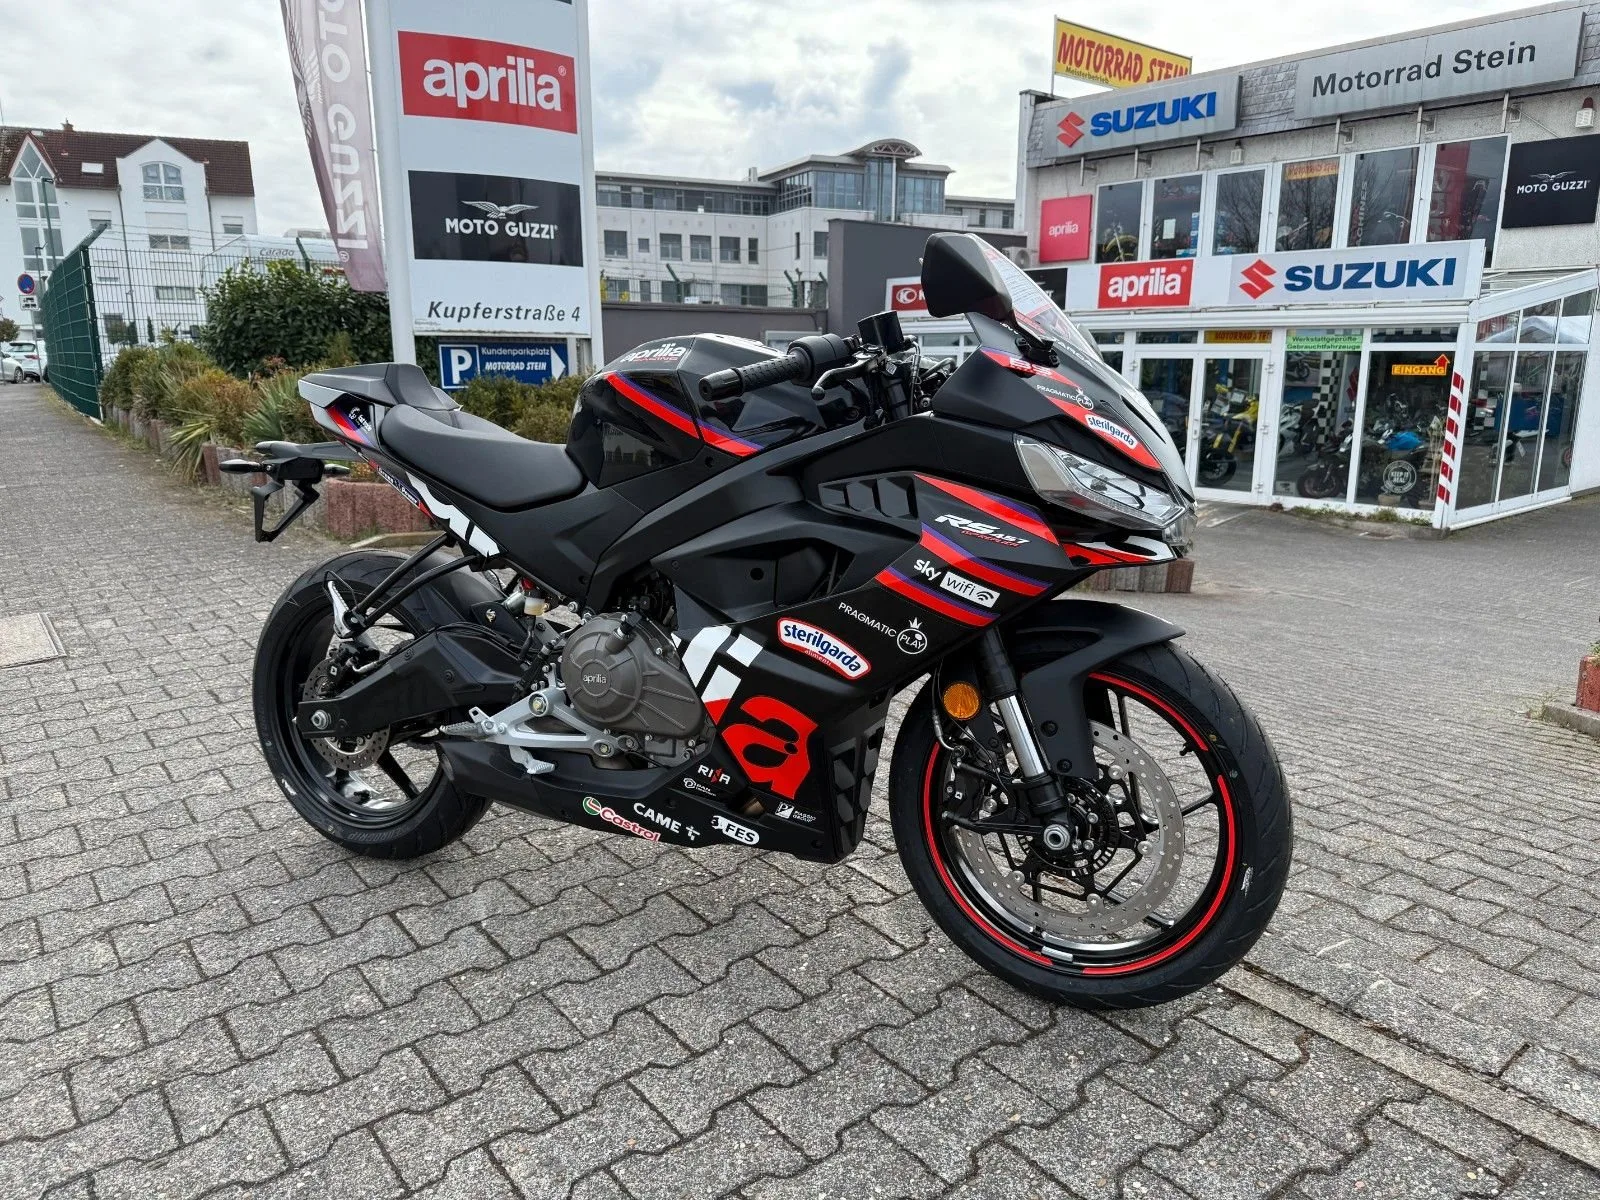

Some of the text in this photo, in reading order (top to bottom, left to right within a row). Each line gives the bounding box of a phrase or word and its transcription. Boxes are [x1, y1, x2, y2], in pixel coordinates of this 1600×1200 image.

[1057, 32, 1143, 83] MOTORRAD
[1312, 41, 1536, 97] Motorrad Stein
[423, 55, 562, 112] aprilia
[1090, 91, 1217, 137] SUZUKI
[1517, 180, 1587, 195] MOTO GUZZI
[445, 218, 556, 239] MOTO GUZZI
[1049, 220, 1079, 237] aprilia
[1108, 267, 1181, 302] aprilia
[1284, 257, 1457, 292] SUZUKI
[428, 301, 581, 323] Kupferstraße 4
[450, 348, 473, 385] P
[481, 347, 550, 357] Kundenparkplatz
[485, 361, 547, 371] MOTORRAD STEIN
[620, 343, 687, 362] aprilia
[1393, 365, 1446, 375] EINGANG
[1036, 384, 1077, 401] PRAGMATIC
[1088, 415, 1135, 446] sterilgarda
[914, 558, 976, 596] sky wifi
[838, 602, 897, 638] PRAGMATIC
[784, 624, 861, 672] sterilgarda
[900, 634, 924, 650] PLAY
[582, 674, 606, 684] aprilia
[600, 807, 662, 842] Castrol
[633, 802, 682, 834] CAME
